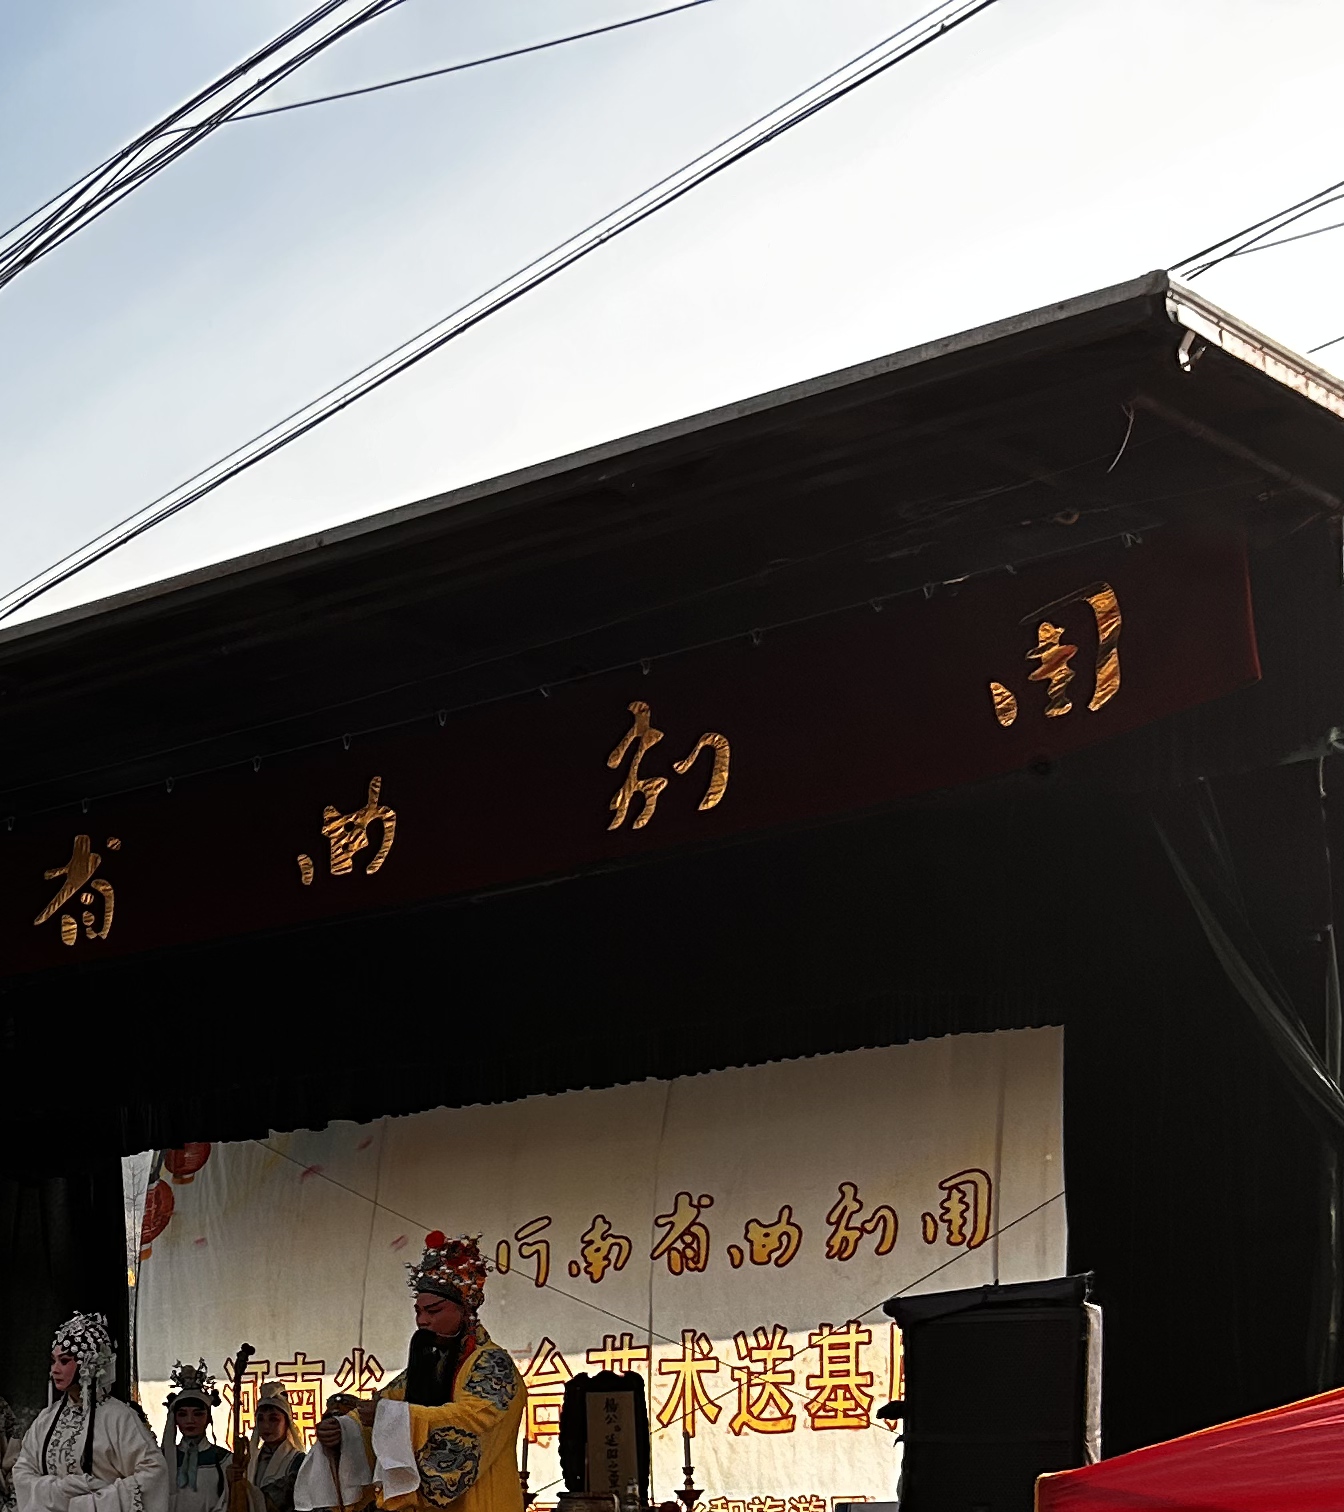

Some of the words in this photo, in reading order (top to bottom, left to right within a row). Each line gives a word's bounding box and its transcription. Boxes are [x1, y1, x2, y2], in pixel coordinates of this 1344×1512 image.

[496, 1167, 993, 1288] 河南省曲剧团
